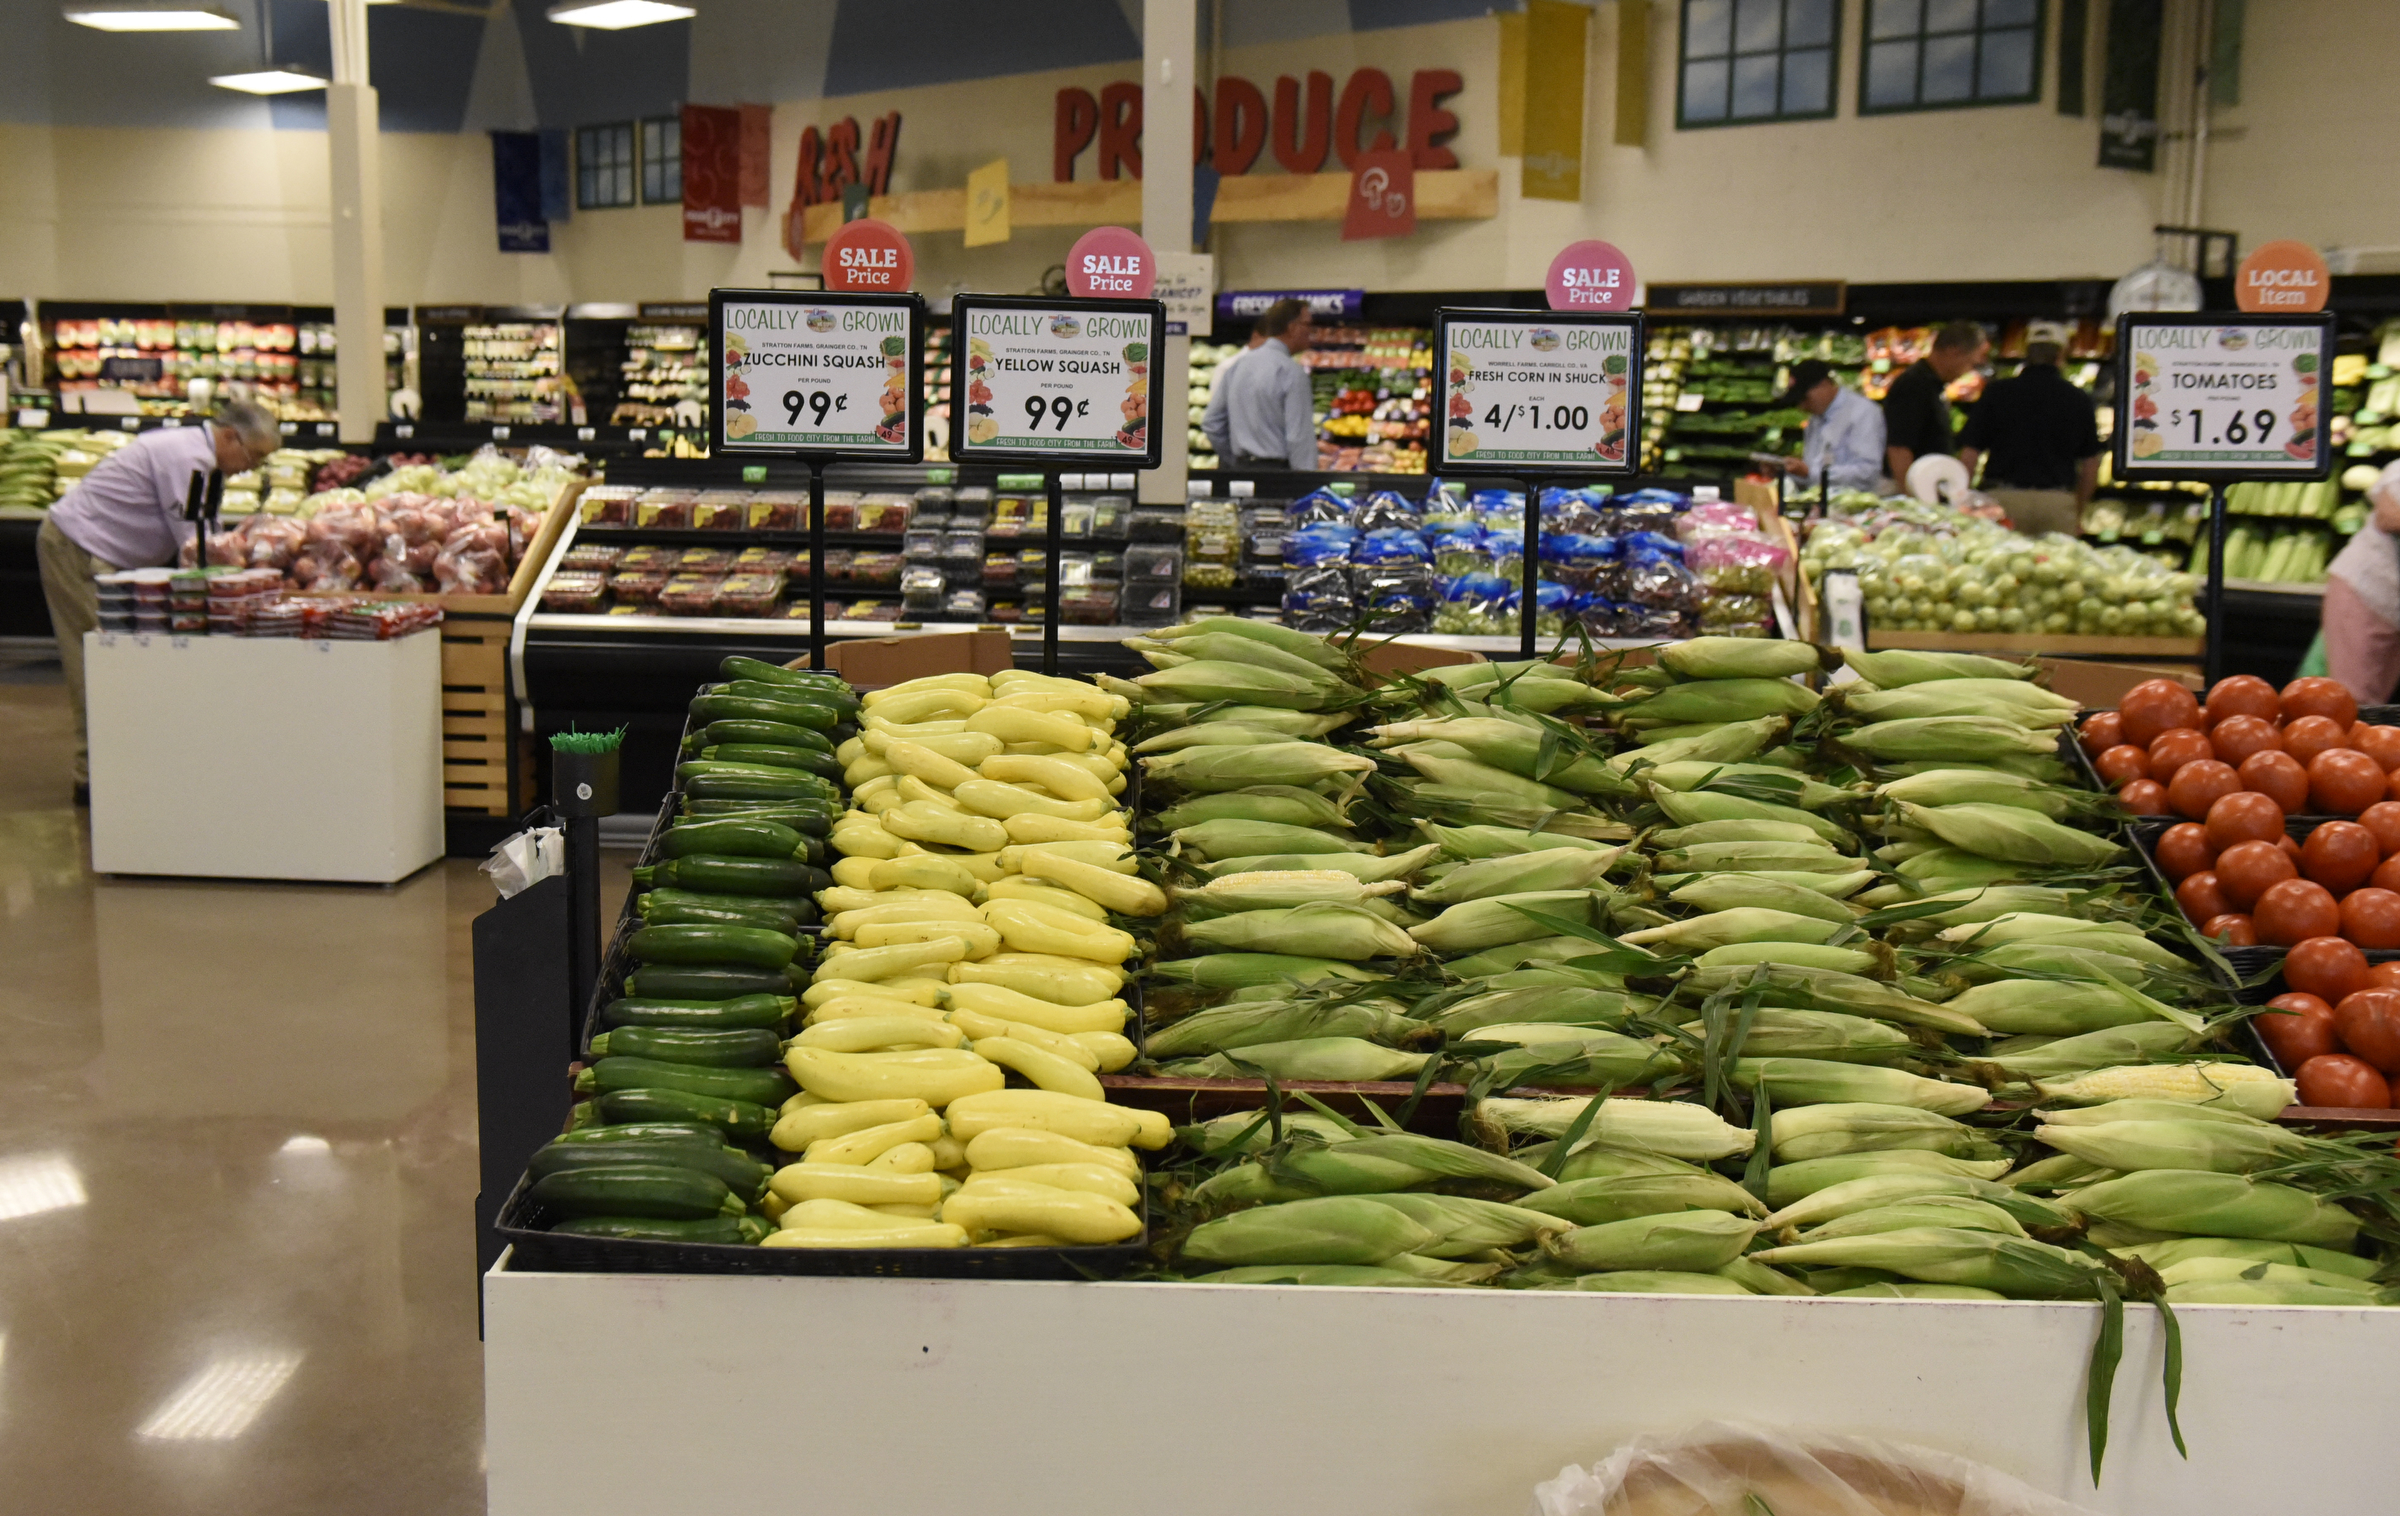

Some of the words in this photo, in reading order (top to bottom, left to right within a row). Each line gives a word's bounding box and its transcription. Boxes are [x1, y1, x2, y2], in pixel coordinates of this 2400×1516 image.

[1054, 66, 1464, 183] PRDUCE
[840, 248, 898, 268] SALE
[1083, 255, 1141, 275] SALE
[847, 268, 890, 285] Price
[1089, 275, 1133, 291] Price
[1562, 267, 1621, 288] SALE
[2248, 270, 2319, 287] LOCAL
[1569, 288, 1613, 304] Price
[2259, 288, 2306, 305] Item
[726, 308, 799, 330] LOCALLY
[843, 311, 904, 332] GROWN
[971, 314, 1044, 335] LOCALLY
[1087, 317, 1148, 338] GROWN
[1452, 328, 1524, 349] LOCALLY
[1566, 330, 1627, 351] GROWN
[2136, 329, 2212, 349] LOCALLY
[2254, 329, 2318, 349] GROWN
[744, 353, 818, 367] ZUCCHINI
[823, 354, 885, 369] SQUASH
[995, 358, 1054, 372] YELLOW
[1059, 360, 1120, 374] SQUASH
[1469, 370, 1504, 382] FRESH
[1507, 371, 1545, 383] CORN
[1549, 372, 1563, 383] IN
[1565, 372, 1606, 384] SHUCK
[2172, 373, 2277, 389] TOMATOES
[782, 390, 848, 427] 99¢
[1025, 395, 1090, 432] 99¢
[1484, 404, 1588, 432] 4/$1.00
[2171, 409, 2277, 444] $1.69
[755, 433, 775, 441] FRESH
[788, 434, 804, 442] FOOD
[806, 434, 820, 442] CITY
[823, 434, 840, 443] FROM
[843, 435, 854, 443] THE
[996, 438, 1016, 446] FRESH
[1018, 438, 1026, 446] TO
[1029, 439, 1046, 447] FOOD
[1048, 439, 1061, 447] CITY
[1064, 439, 1081, 448] FROM
[1083, 440, 1094, 448] THE
[1476, 451, 1495, 459] FRESH
[1498, 451, 1506, 459] TO
[1508, 451, 1524, 459] FOOD
[1526, 452, 1541, 460] CITY
[1543, 452, 1560, 460] FROM
[1563, 452, 1574, 460] THE
